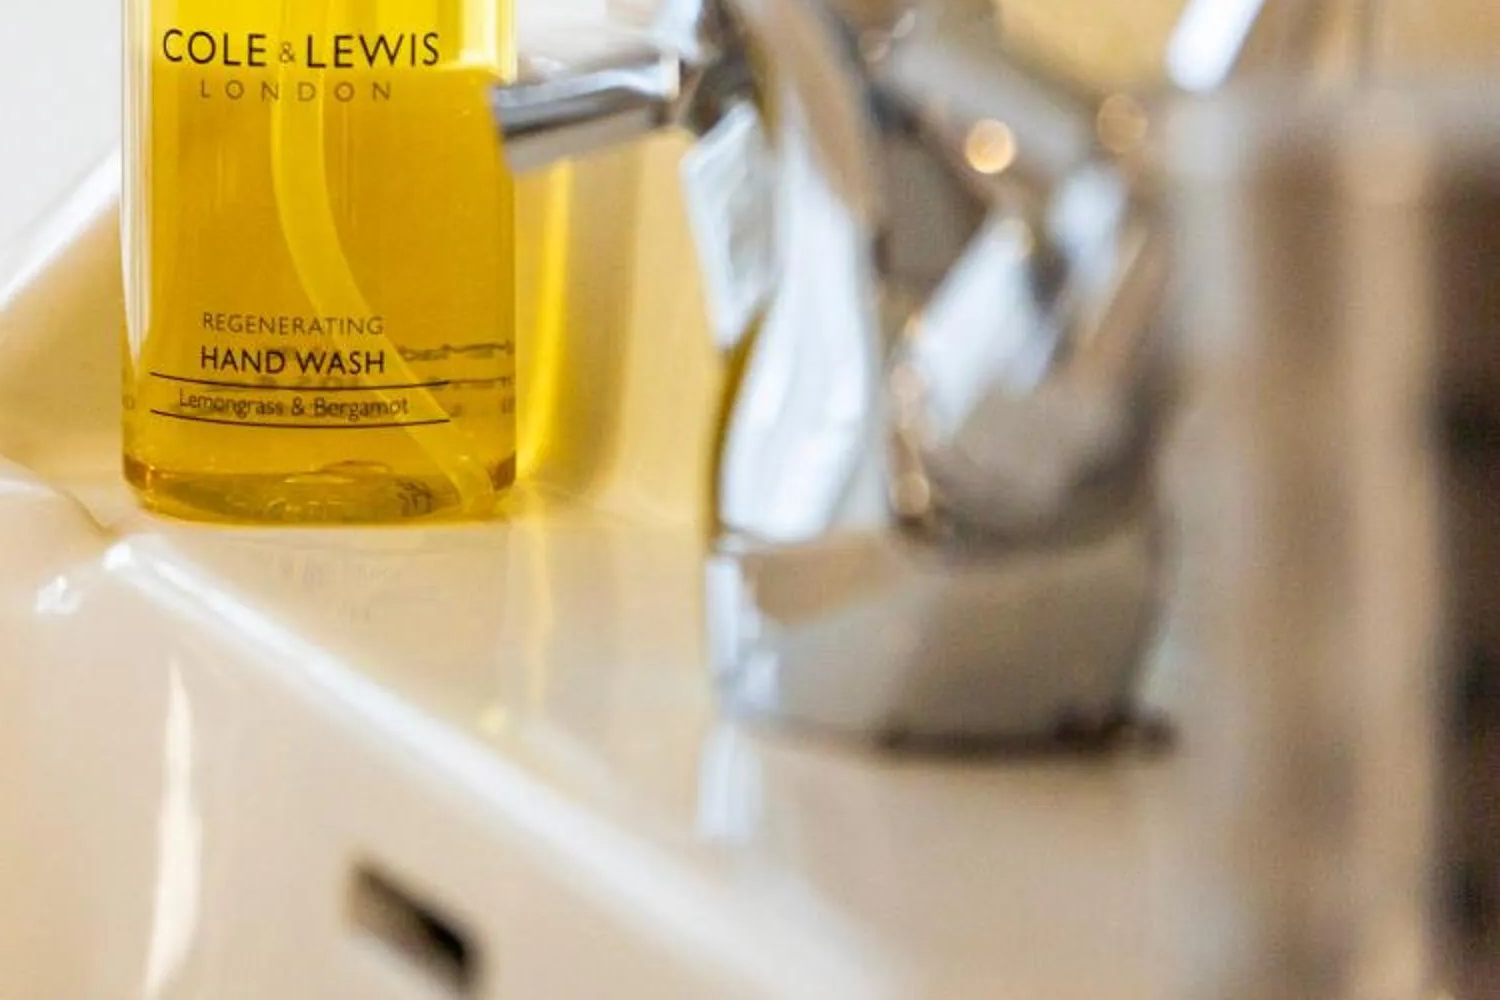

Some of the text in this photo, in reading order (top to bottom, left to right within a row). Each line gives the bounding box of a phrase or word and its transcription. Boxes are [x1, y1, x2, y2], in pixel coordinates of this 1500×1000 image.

[163, 28, 440, 69] COLE & LEWIS
[200, 79, 392, 102] LONDON
[202, 311, 385, 336] REGENERATING
[200, 345, 286, 374] HAND
[297, 349, 385, 375] WASH
[179, 388, 408, 422] Lemongrass & Bergamot
